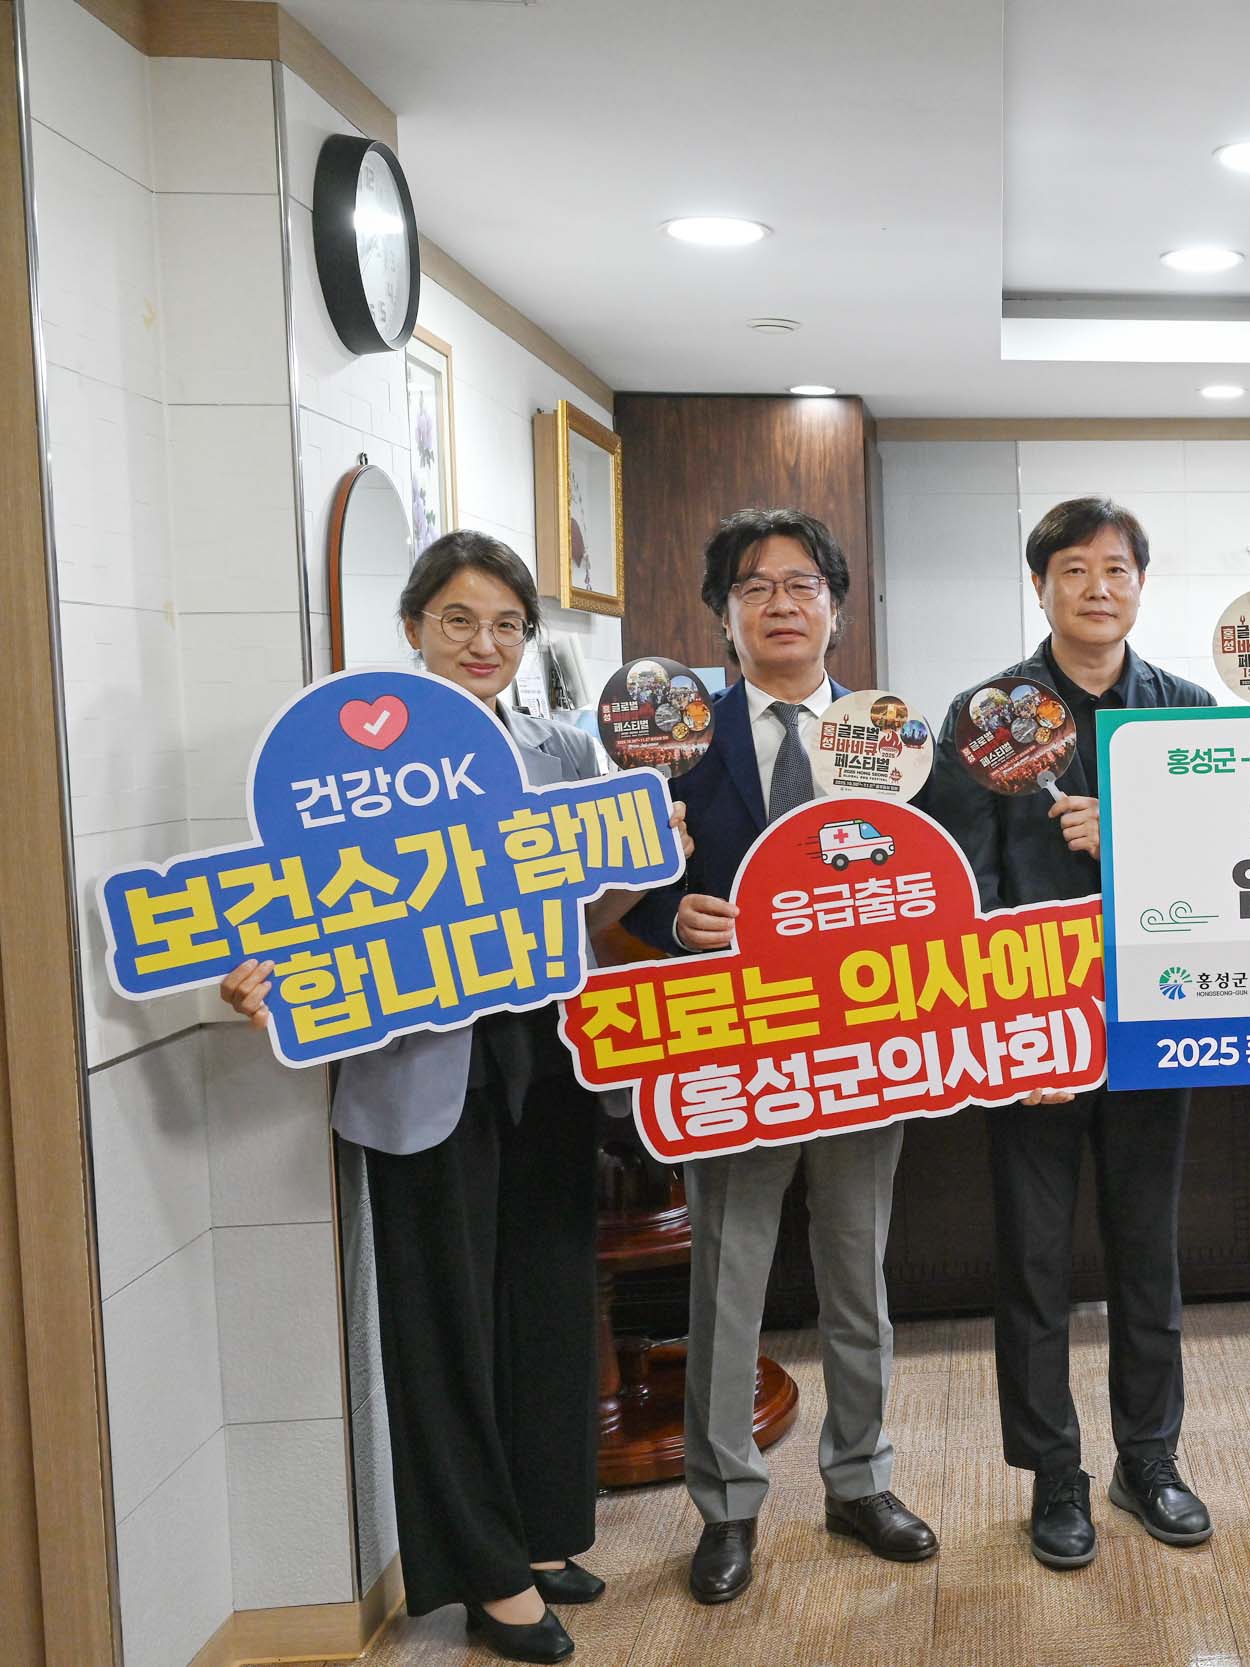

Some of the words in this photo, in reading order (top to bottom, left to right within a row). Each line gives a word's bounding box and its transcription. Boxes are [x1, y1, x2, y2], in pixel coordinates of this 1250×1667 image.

[1223, 627, 1236, 652] 홍성
[822, 723, 835, 749] 홍성
[836, 738, 878, 756] 바비큐
[837, 723, 880, 742] 글로벌
[834, 753, 890, 773] 페스티벌
[1167, 746, 1237, 776] 홍성군
[291, 752, 485, 829] 건강OK
[125, 824, 484, 975] 보건소가
[498, 788, 664, 895] 함께
[771, 871, 937, 937] 응급출동
[273, 900, 565, 1044] 합니다!
[1196, 972, 1248, 990] 홍성군
[1196, 989, 1248, 997] HONGSEONG-GUN
[580, 966, 820, 1070] 진료는
[1156, 1036, 1239, 1069] 2025
[653, 1007, 1092, 1141] (홍성군의사회)
